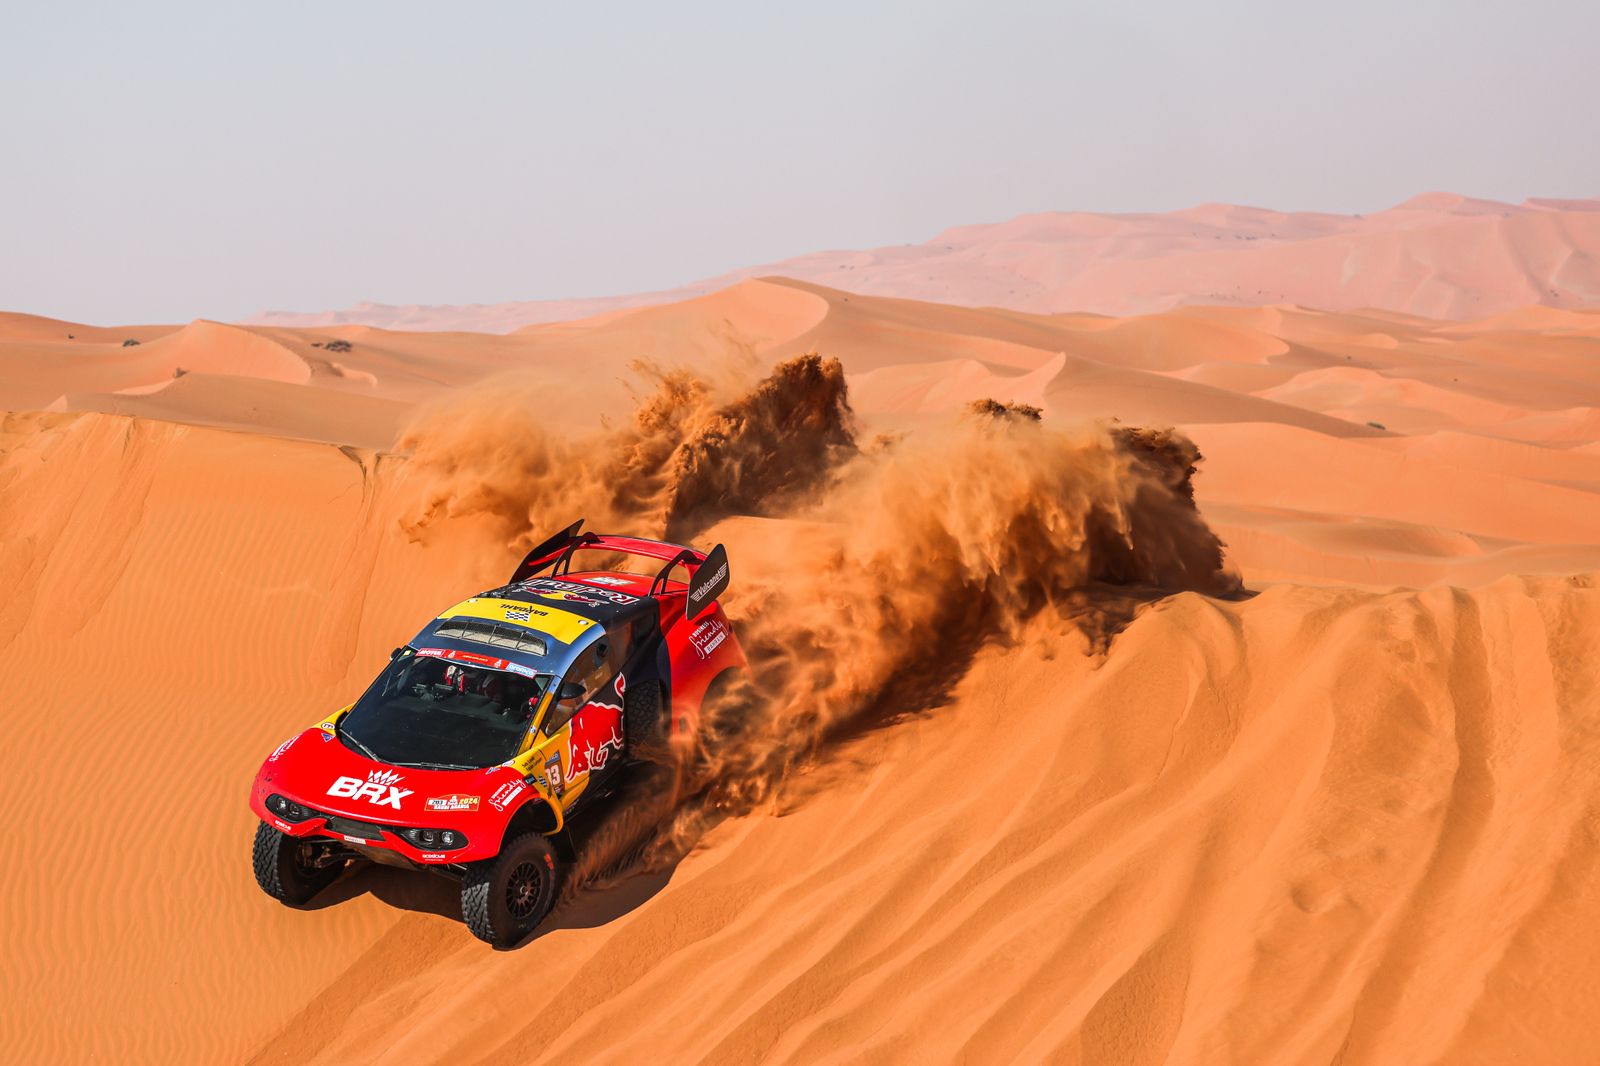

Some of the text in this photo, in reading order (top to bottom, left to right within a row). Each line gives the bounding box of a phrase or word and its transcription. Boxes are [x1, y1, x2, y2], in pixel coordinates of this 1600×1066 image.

[577, 583, 640, 605] Red
[698, 569, 721, 596] Vulcanet
[500, 604, 549, 617] BARDAHL
[688, 619, 728, 659] friendly
[509, 663, 537, 676] aramco
[326, 775, 415, 810] BRX
[460, 797, 478, 805] 2024
[488, 778, 526, 812] friendly
